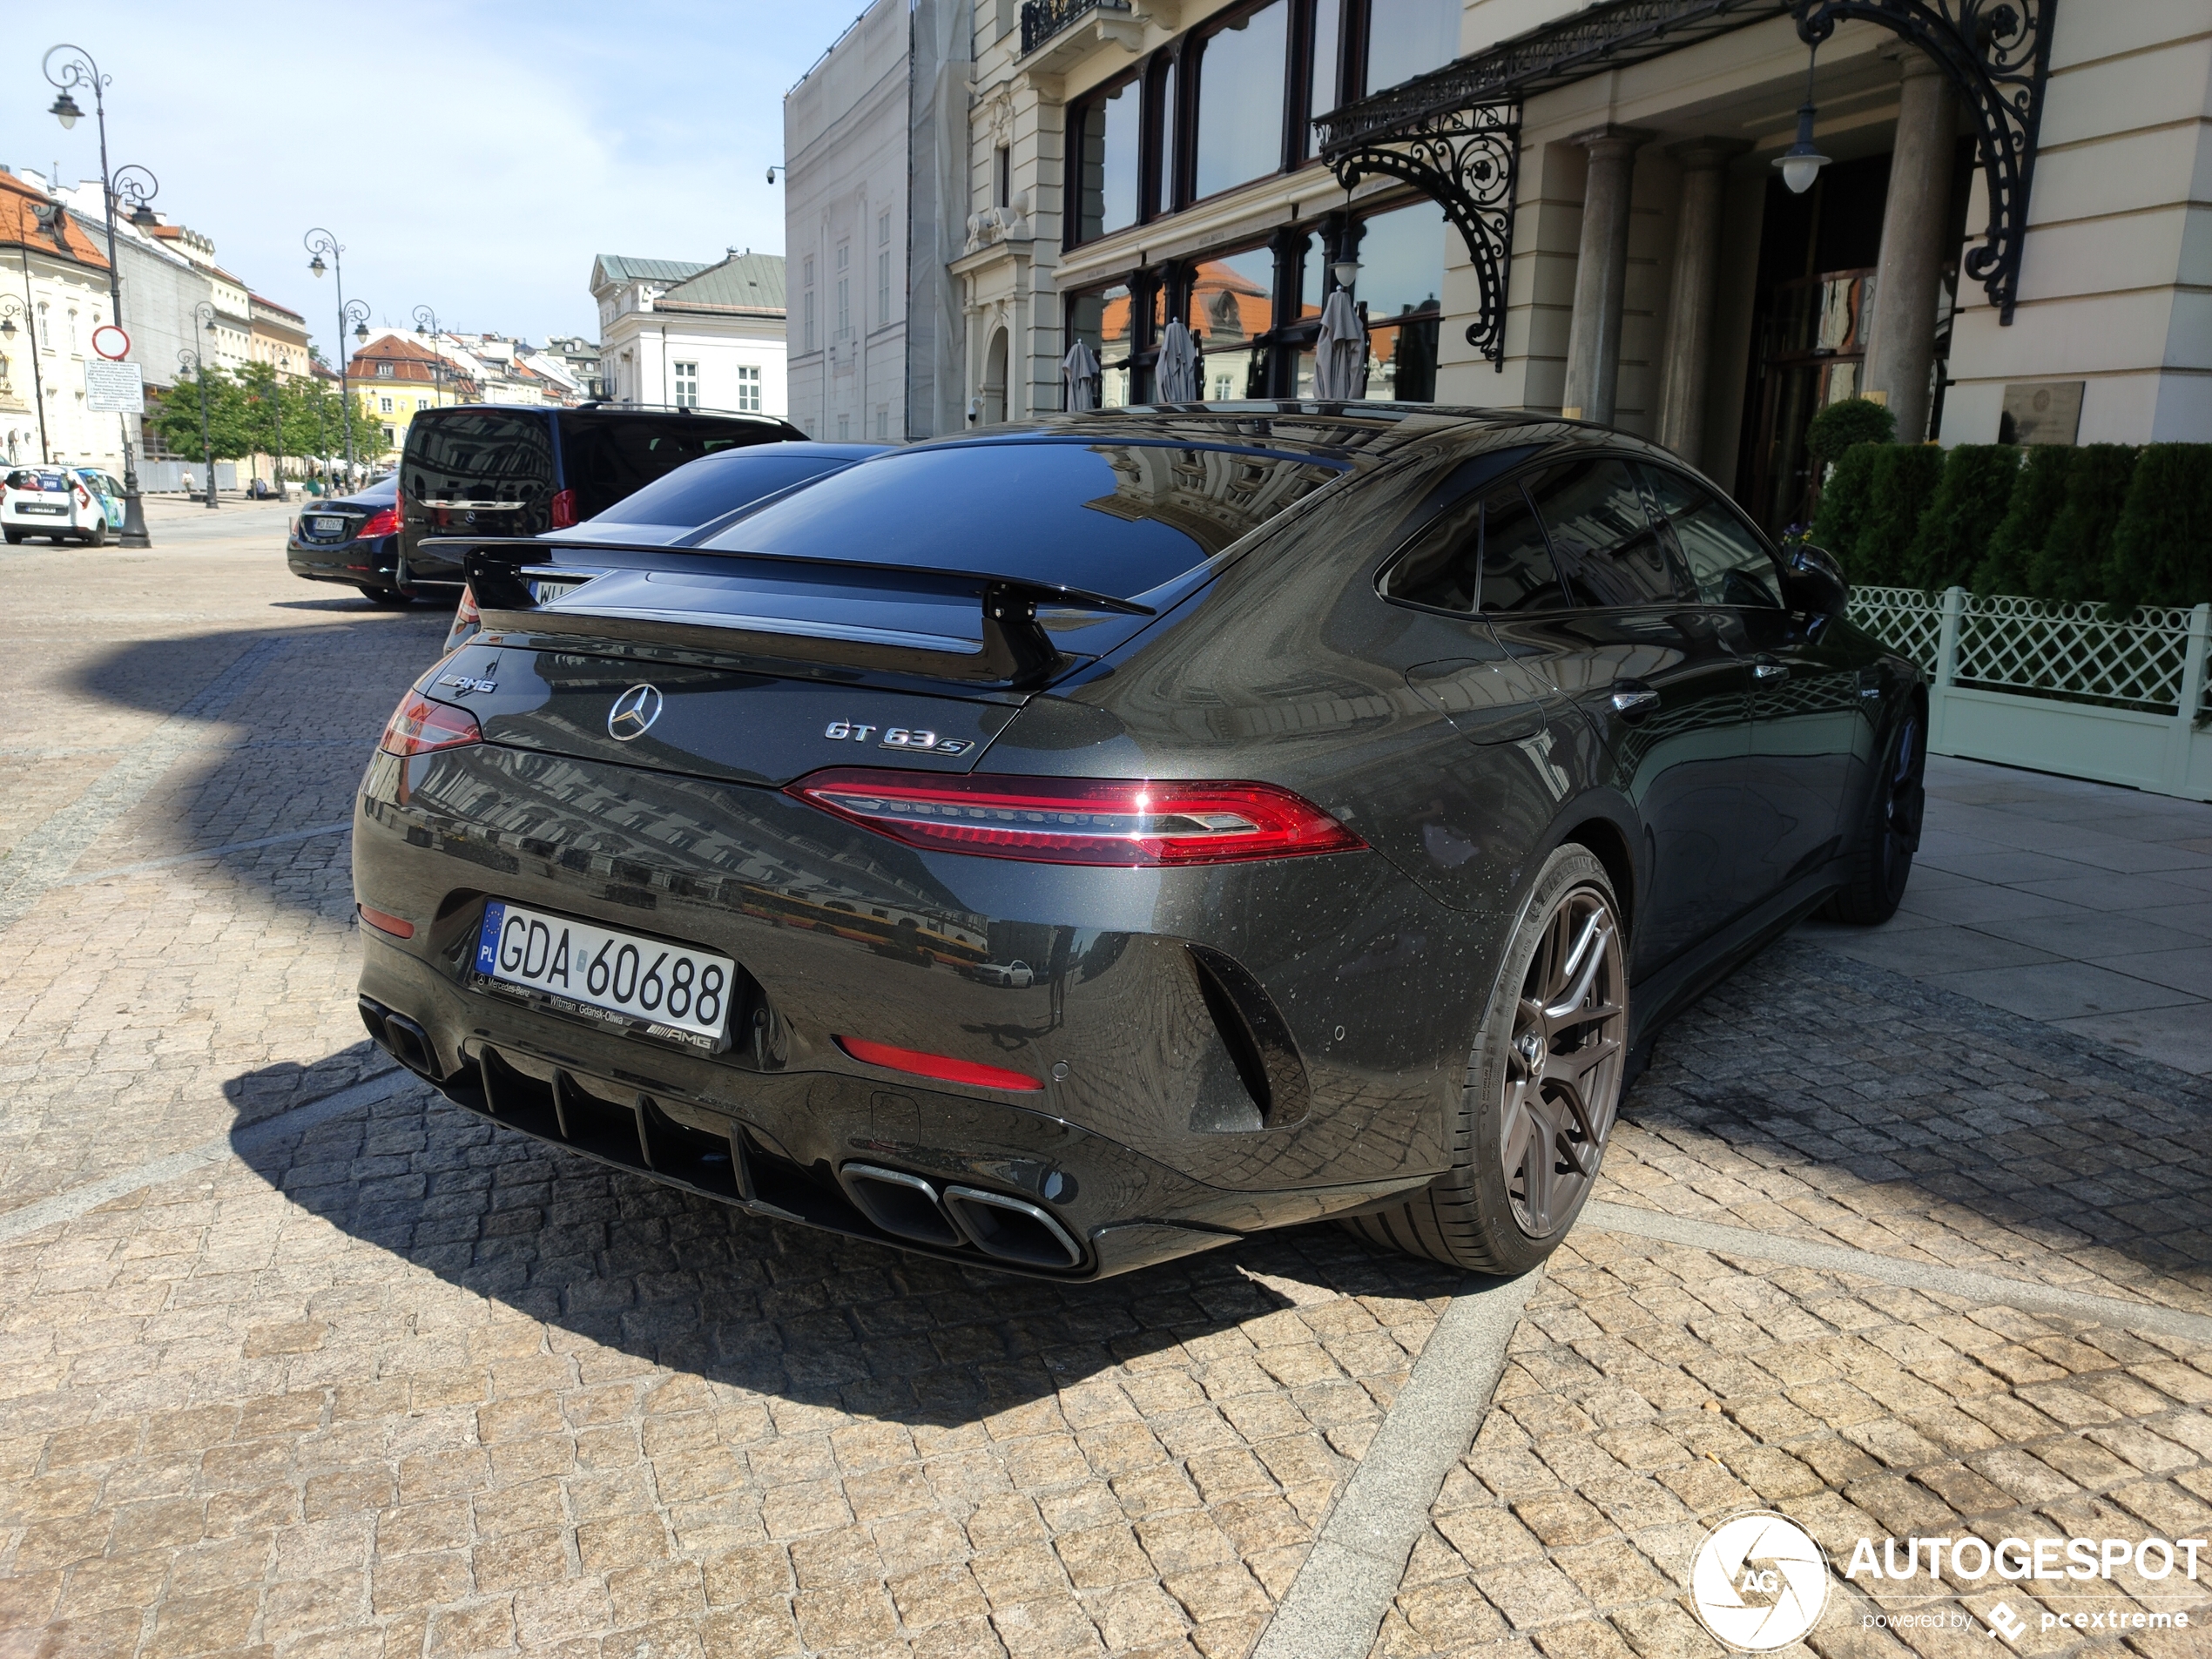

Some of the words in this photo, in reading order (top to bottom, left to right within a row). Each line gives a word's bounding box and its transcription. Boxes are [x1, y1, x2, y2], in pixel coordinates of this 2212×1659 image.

[825, 721, 877, 742] GT
[1540, 856, 1593, 900] MICHELIN
[480, 945, 494, 963] PL
[499, 915, 570, 989] GDA
[586, 939, 724, 1026] 60688
[488, 977, 530, 998] Mercedes-Benz
[550, 995, 577, 1012] Witman
[578, 1003, 624, 1025] Gdańsk-Oliwa
[664, 1028, 711, 1049] AMG
